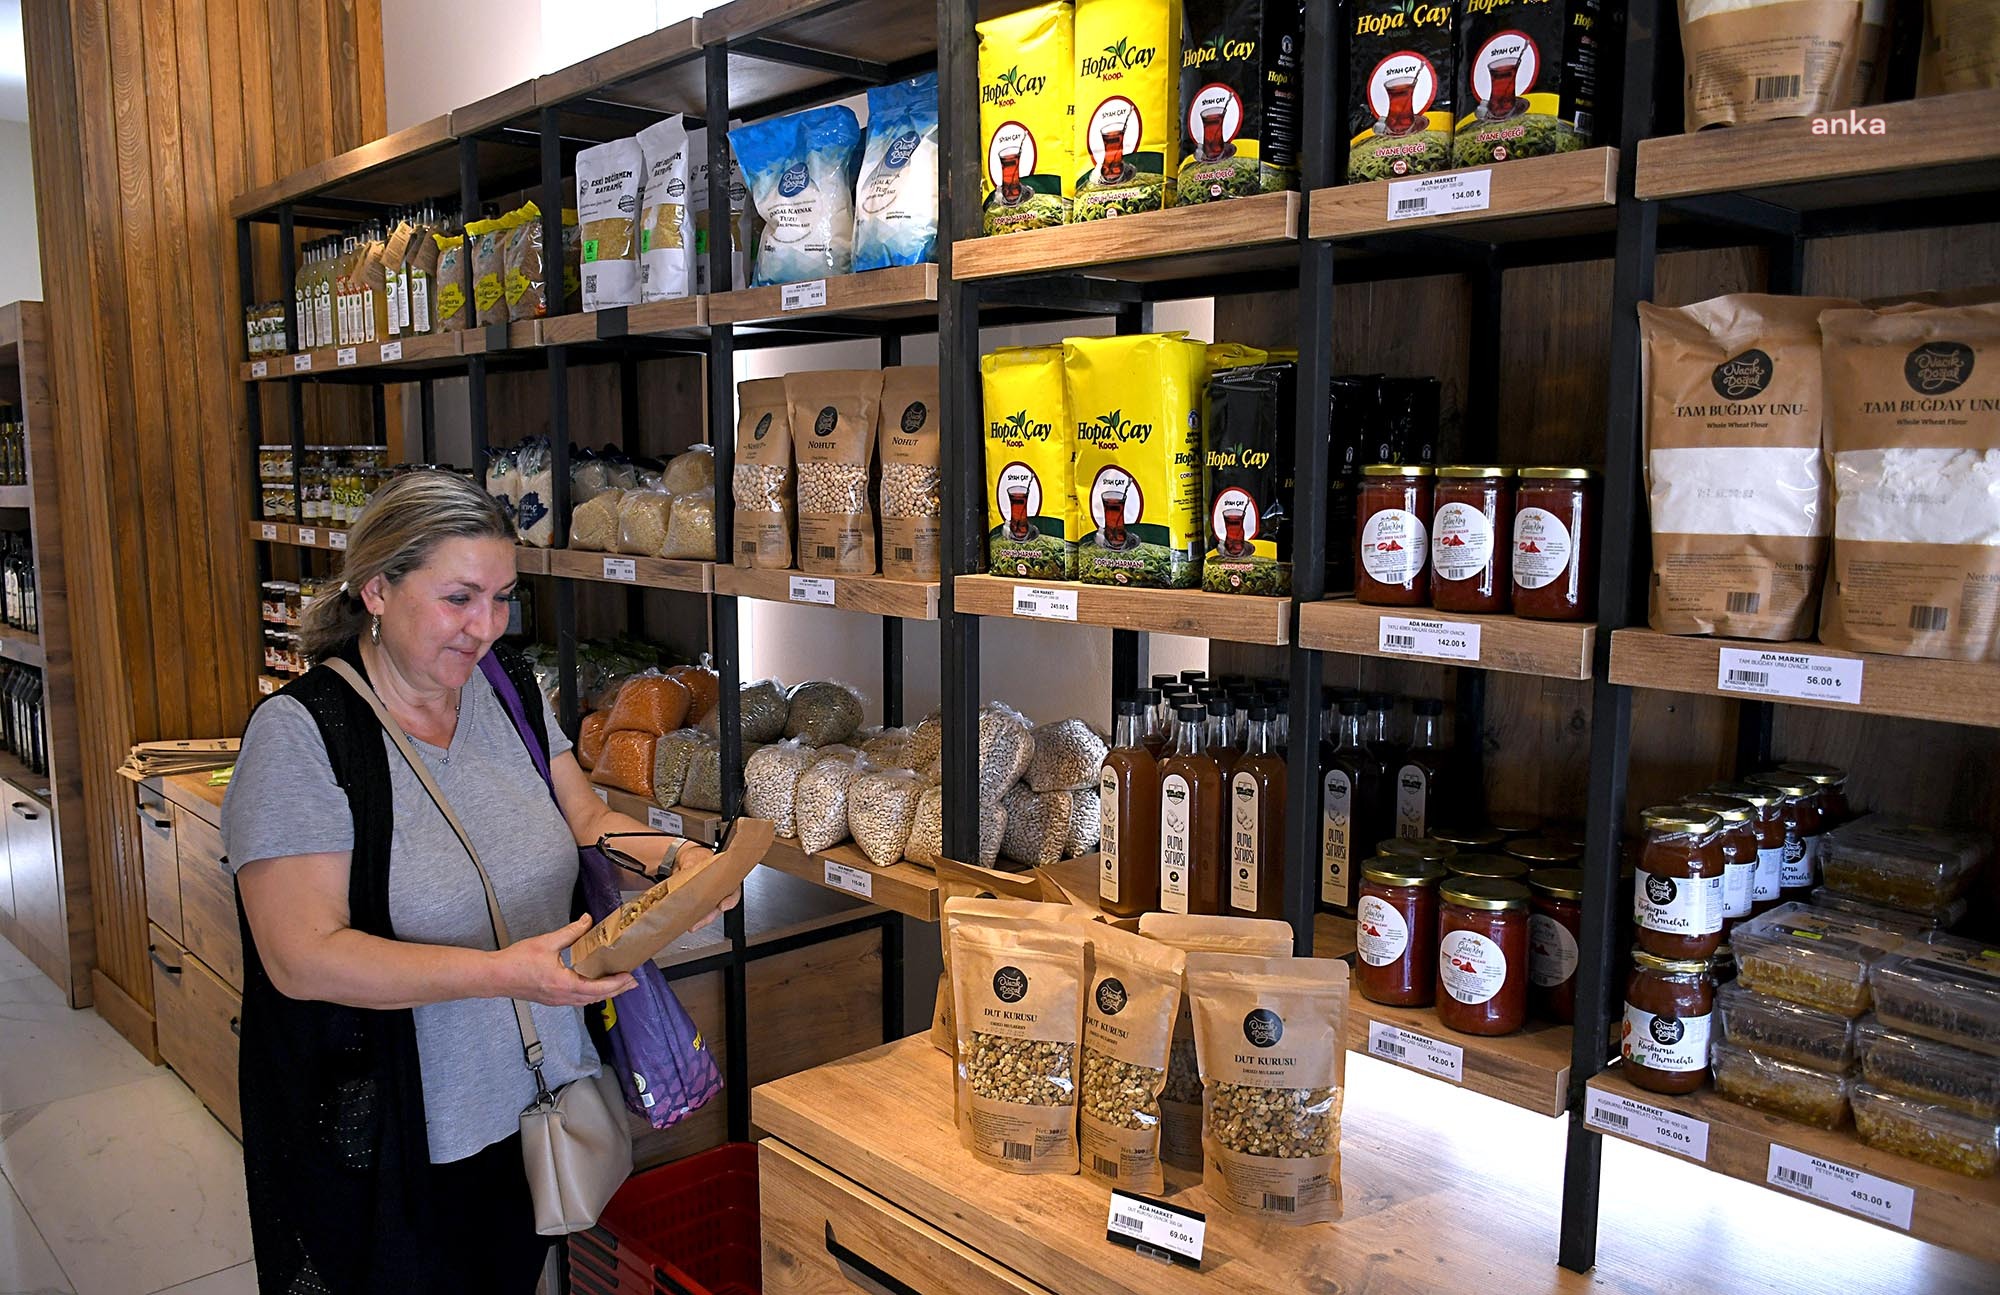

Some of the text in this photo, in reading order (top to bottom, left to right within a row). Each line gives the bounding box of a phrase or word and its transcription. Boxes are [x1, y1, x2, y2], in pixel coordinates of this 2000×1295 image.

[1356, 4, 1450, 35] Hopa Çay
[1183, 48, 1216, 68] Hopa
[1223, 40, 1255, 61] Çay
[1491, 46, 1520, 56] SİYAH ÇAY
[1081, 45, 1155, 76] Hopa Çay
[1103, 72, 1123, 82] Koop.
[1386, 65, 1416, 75] SİYAH ÇAY
[982, 74, 1046, 105] Hopa Çay
[999, 99, 1016, 108] Koop.
[1452, 191, 1474, 199] 134.00
[1915, 349, 1964, 368] Ovacık
[1721, 359, 1764, 376] Ovacık
[1918, 367, 1961, 389] Doğal
[1723, 375, 1761, 396] Doğal
[1710, 402, 1766, 416] BUĞDAY
[1900, 398, 1966, 412] BUĞDAY
[991, 420, 1052, 442] Hopa Çay
[1078, 420, 1152, 445] Hopa Çay
[808, 441, 836, 449] NOHUT
[1007, 439, 1024, 448] Koop.
[1099, 441, 1119, 450] Koop.
[1206, 449, 1270, 470] Hopa Çay
[1438, 639, 1460, 647] 142.00
[1779, 655, 1809, 664] MARKET
[1807, 676, 1832, 686] 56.00
[984, 1008, 1037, 1022] DUT KURUSU
[1086, 1016, 1129, 1039] DUT KURUSU
[1412, 1035, 1433, 1045] MARKET
[1235, 1054, 1297, 1066] DUT KURUSU
[1428, 1055, 1449, 1066] 142.00
[1622, 1100, 1664, 1117] ADA MARKET
[1656, 1127, 1683, 1141] 105.00
[1811, 1159, 1860, 1179] ADA MARKET
[1851, 1190, 1882, 1206] 483.00
[1151, 1208, 1173, 1219] MARKET
[1170, 1230, 1188, 1242] 69.00
